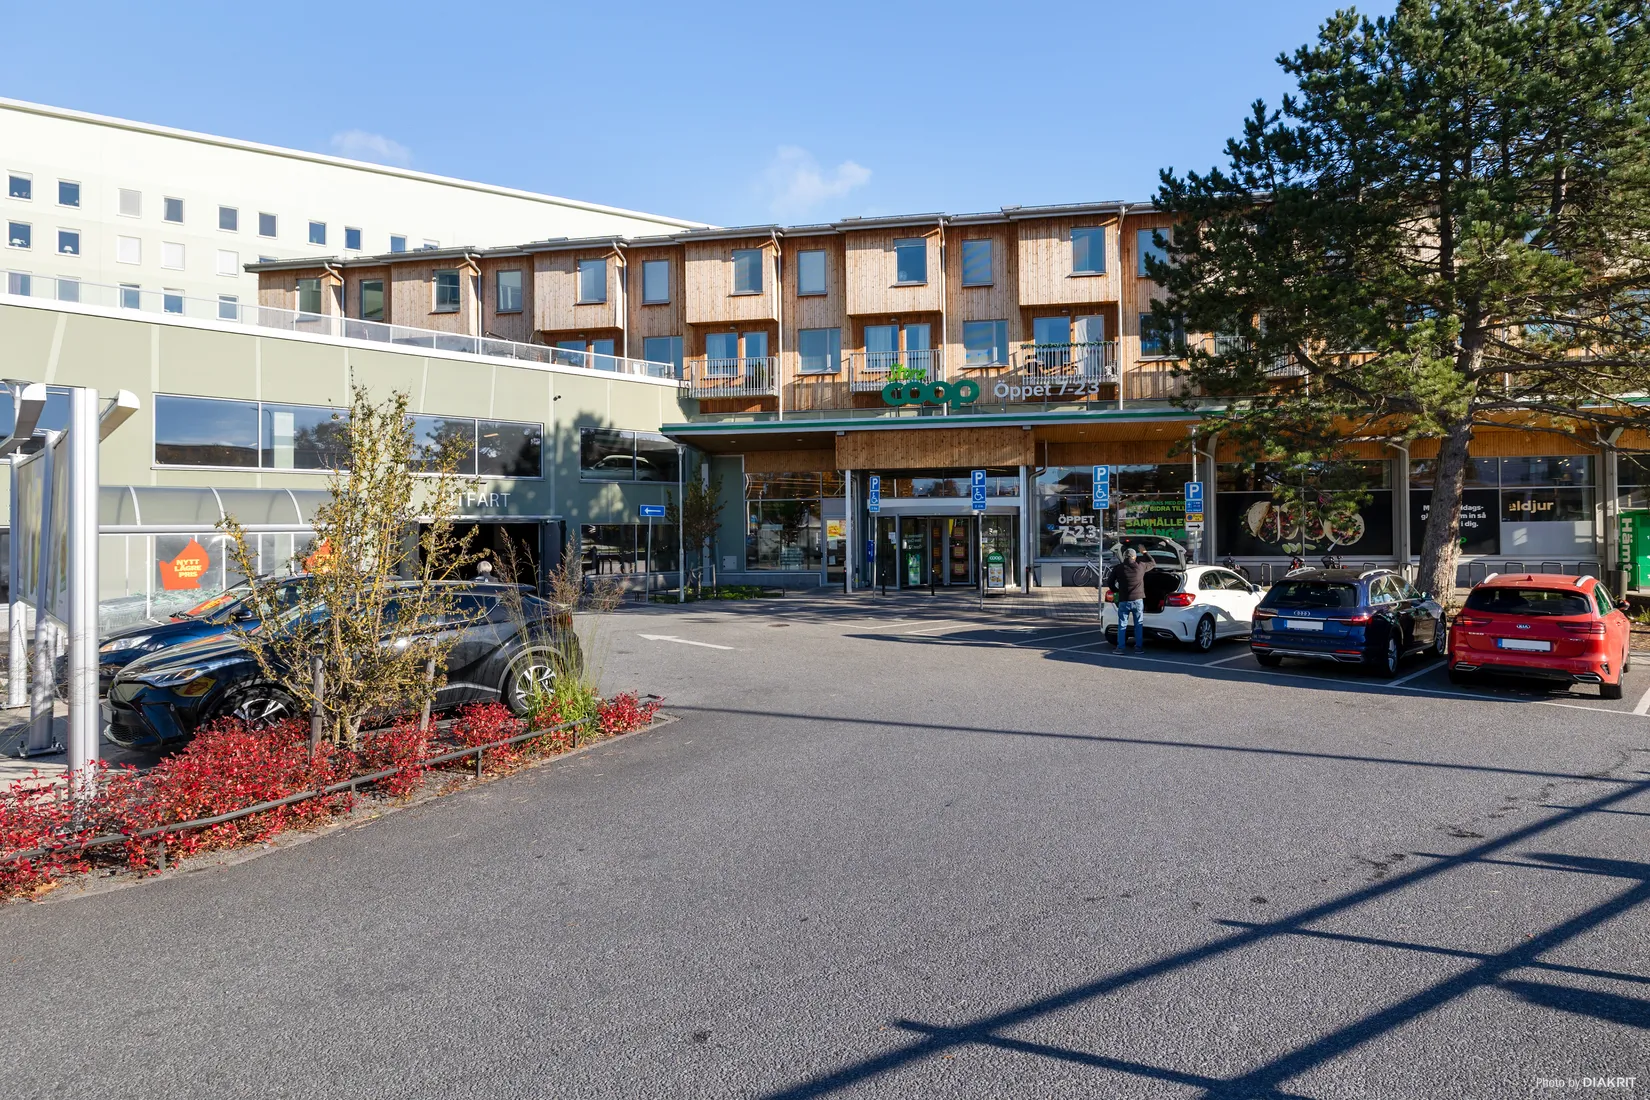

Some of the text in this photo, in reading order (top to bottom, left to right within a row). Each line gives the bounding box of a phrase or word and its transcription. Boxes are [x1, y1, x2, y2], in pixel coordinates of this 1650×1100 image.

[886, 363, 926, 382] Stora
[882, 380, 980, 409] coop
[994, 380, 1100, 400] Öppet 7-23
[975, 472, 983, 485] P
[1098, 467, 1107, 481] P
[872, 478, 878, 489] P
[1190, 484, 1199, 498] P
[1058, 514, 1095, 524] ÖPPET
[1477, 511, 1487, 519] så
[1464, 520, 1479, 528] dig.
